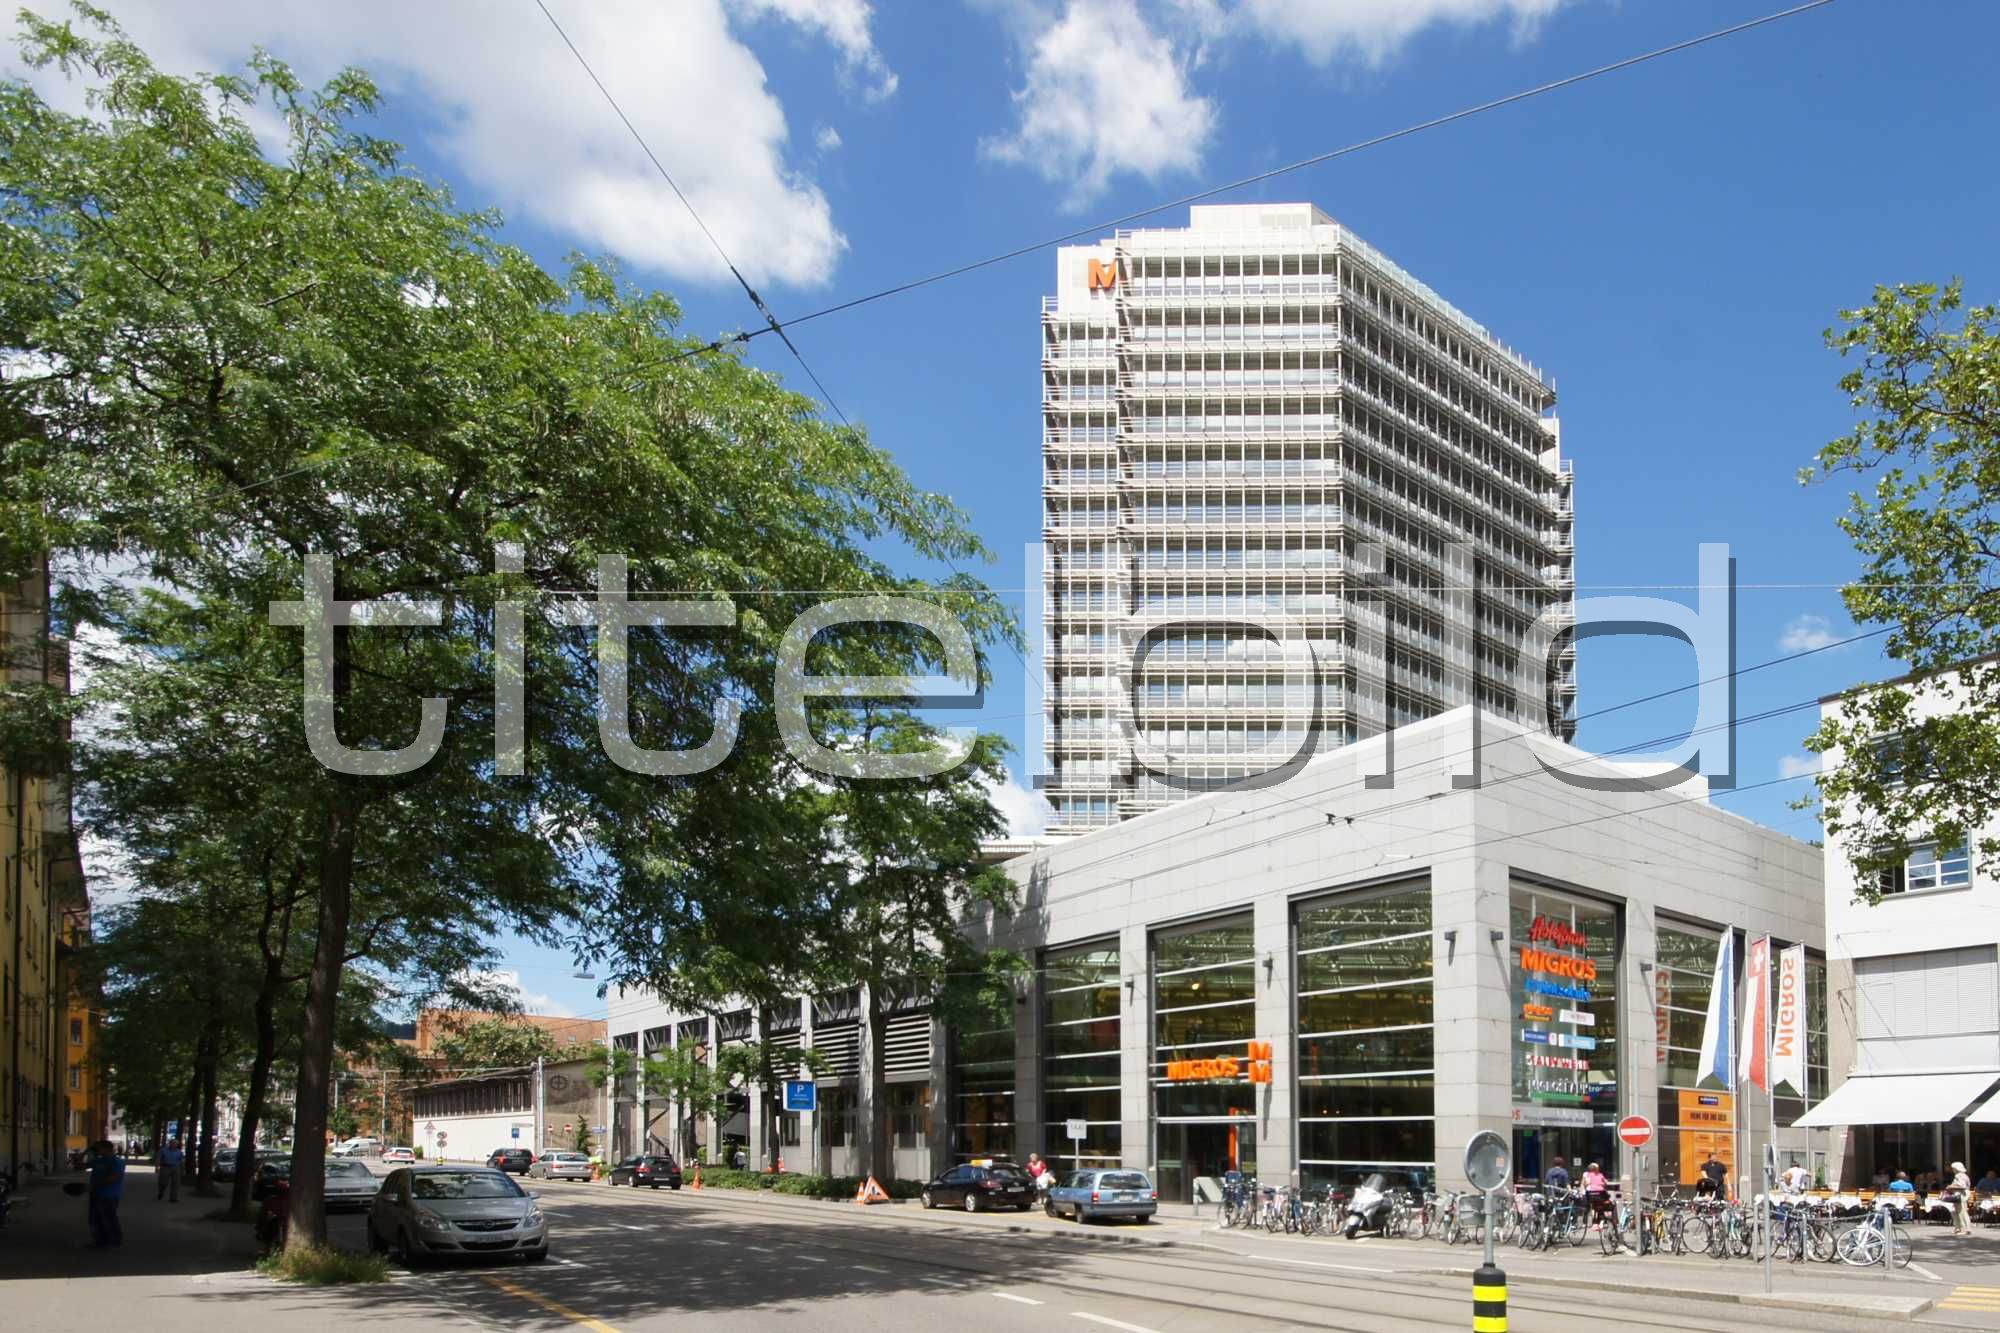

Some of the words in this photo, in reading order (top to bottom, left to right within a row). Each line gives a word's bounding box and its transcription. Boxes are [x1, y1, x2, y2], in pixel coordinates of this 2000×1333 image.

[1087, 258, 1119, 289] M
[1520, 945, 1597, 981] MIGROS
[1168, 1057, 1239, 1080] MIGROS
[797, 1085, 804, 1094] P
